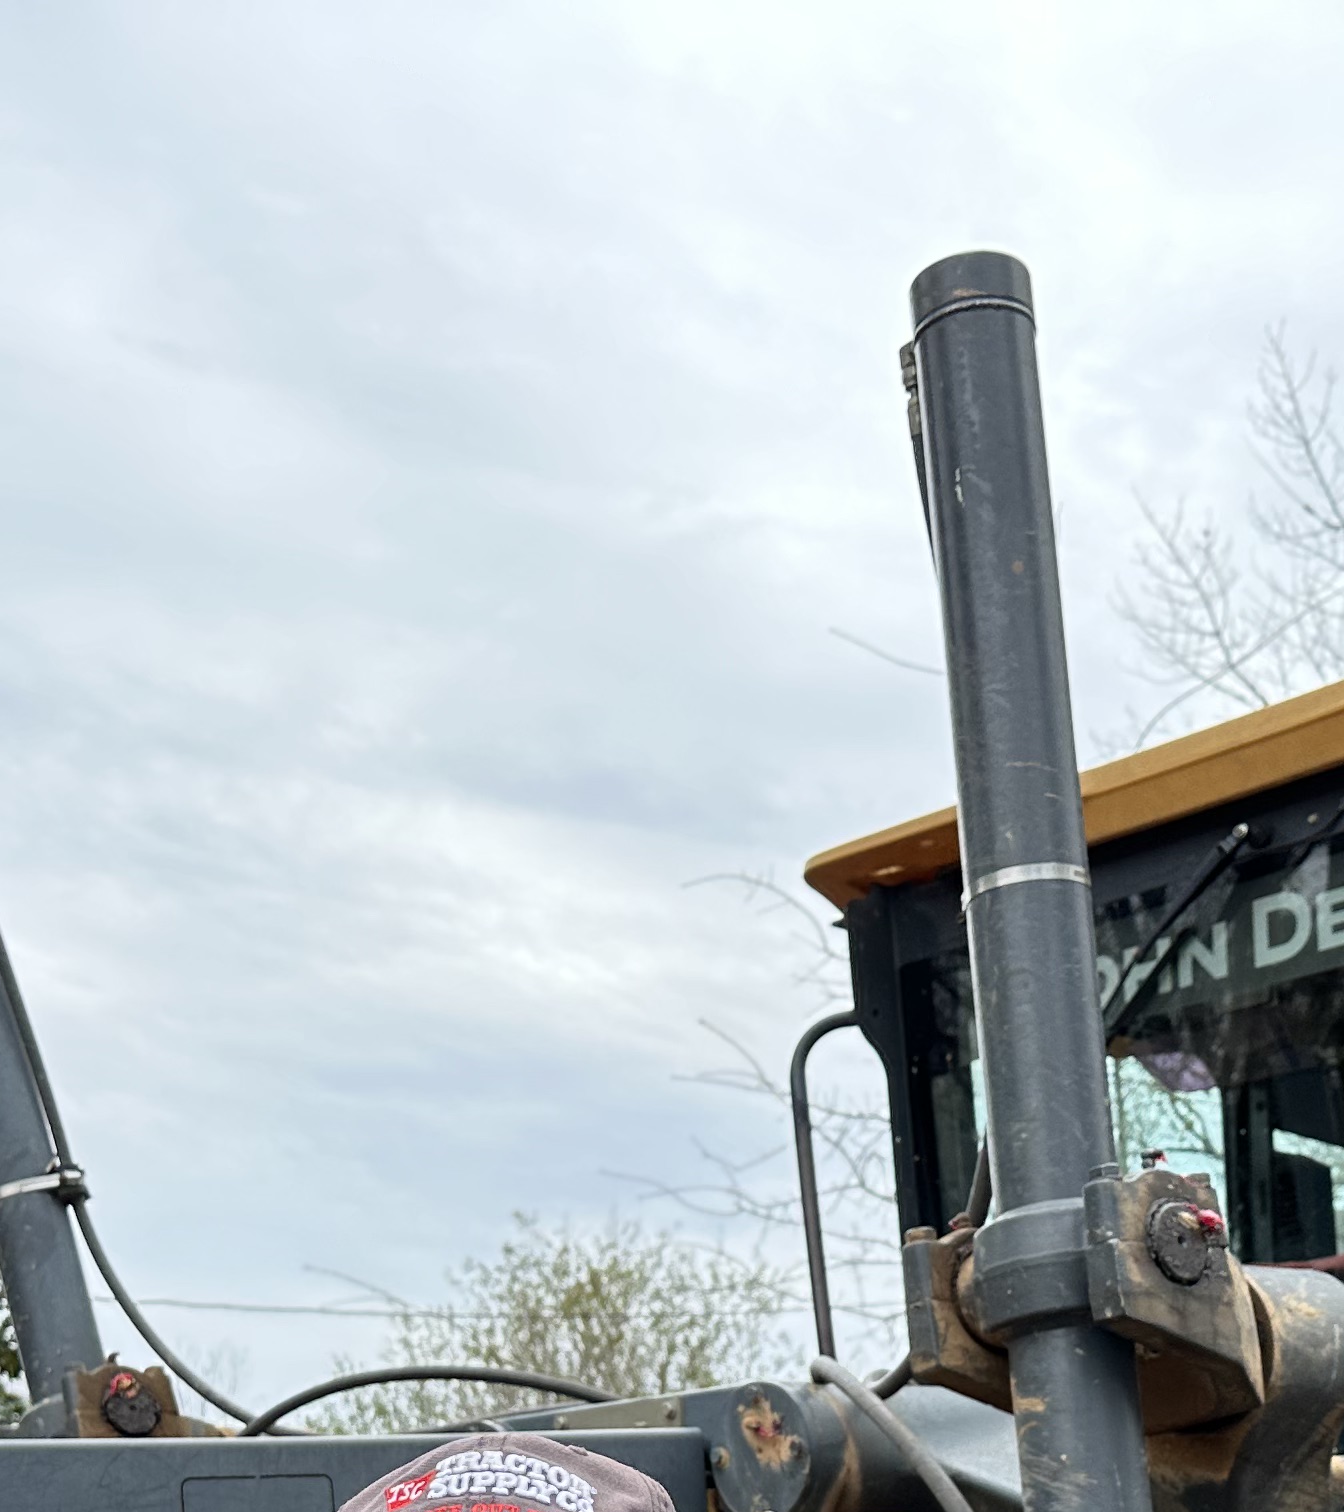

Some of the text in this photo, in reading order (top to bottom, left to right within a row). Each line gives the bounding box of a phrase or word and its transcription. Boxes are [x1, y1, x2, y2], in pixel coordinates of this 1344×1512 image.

[387, 1479, 426, 1504] TSC
[427, 1471, 559, 1504] SUPPLY
[435, 1450, 594, 1503] TRACTOR
